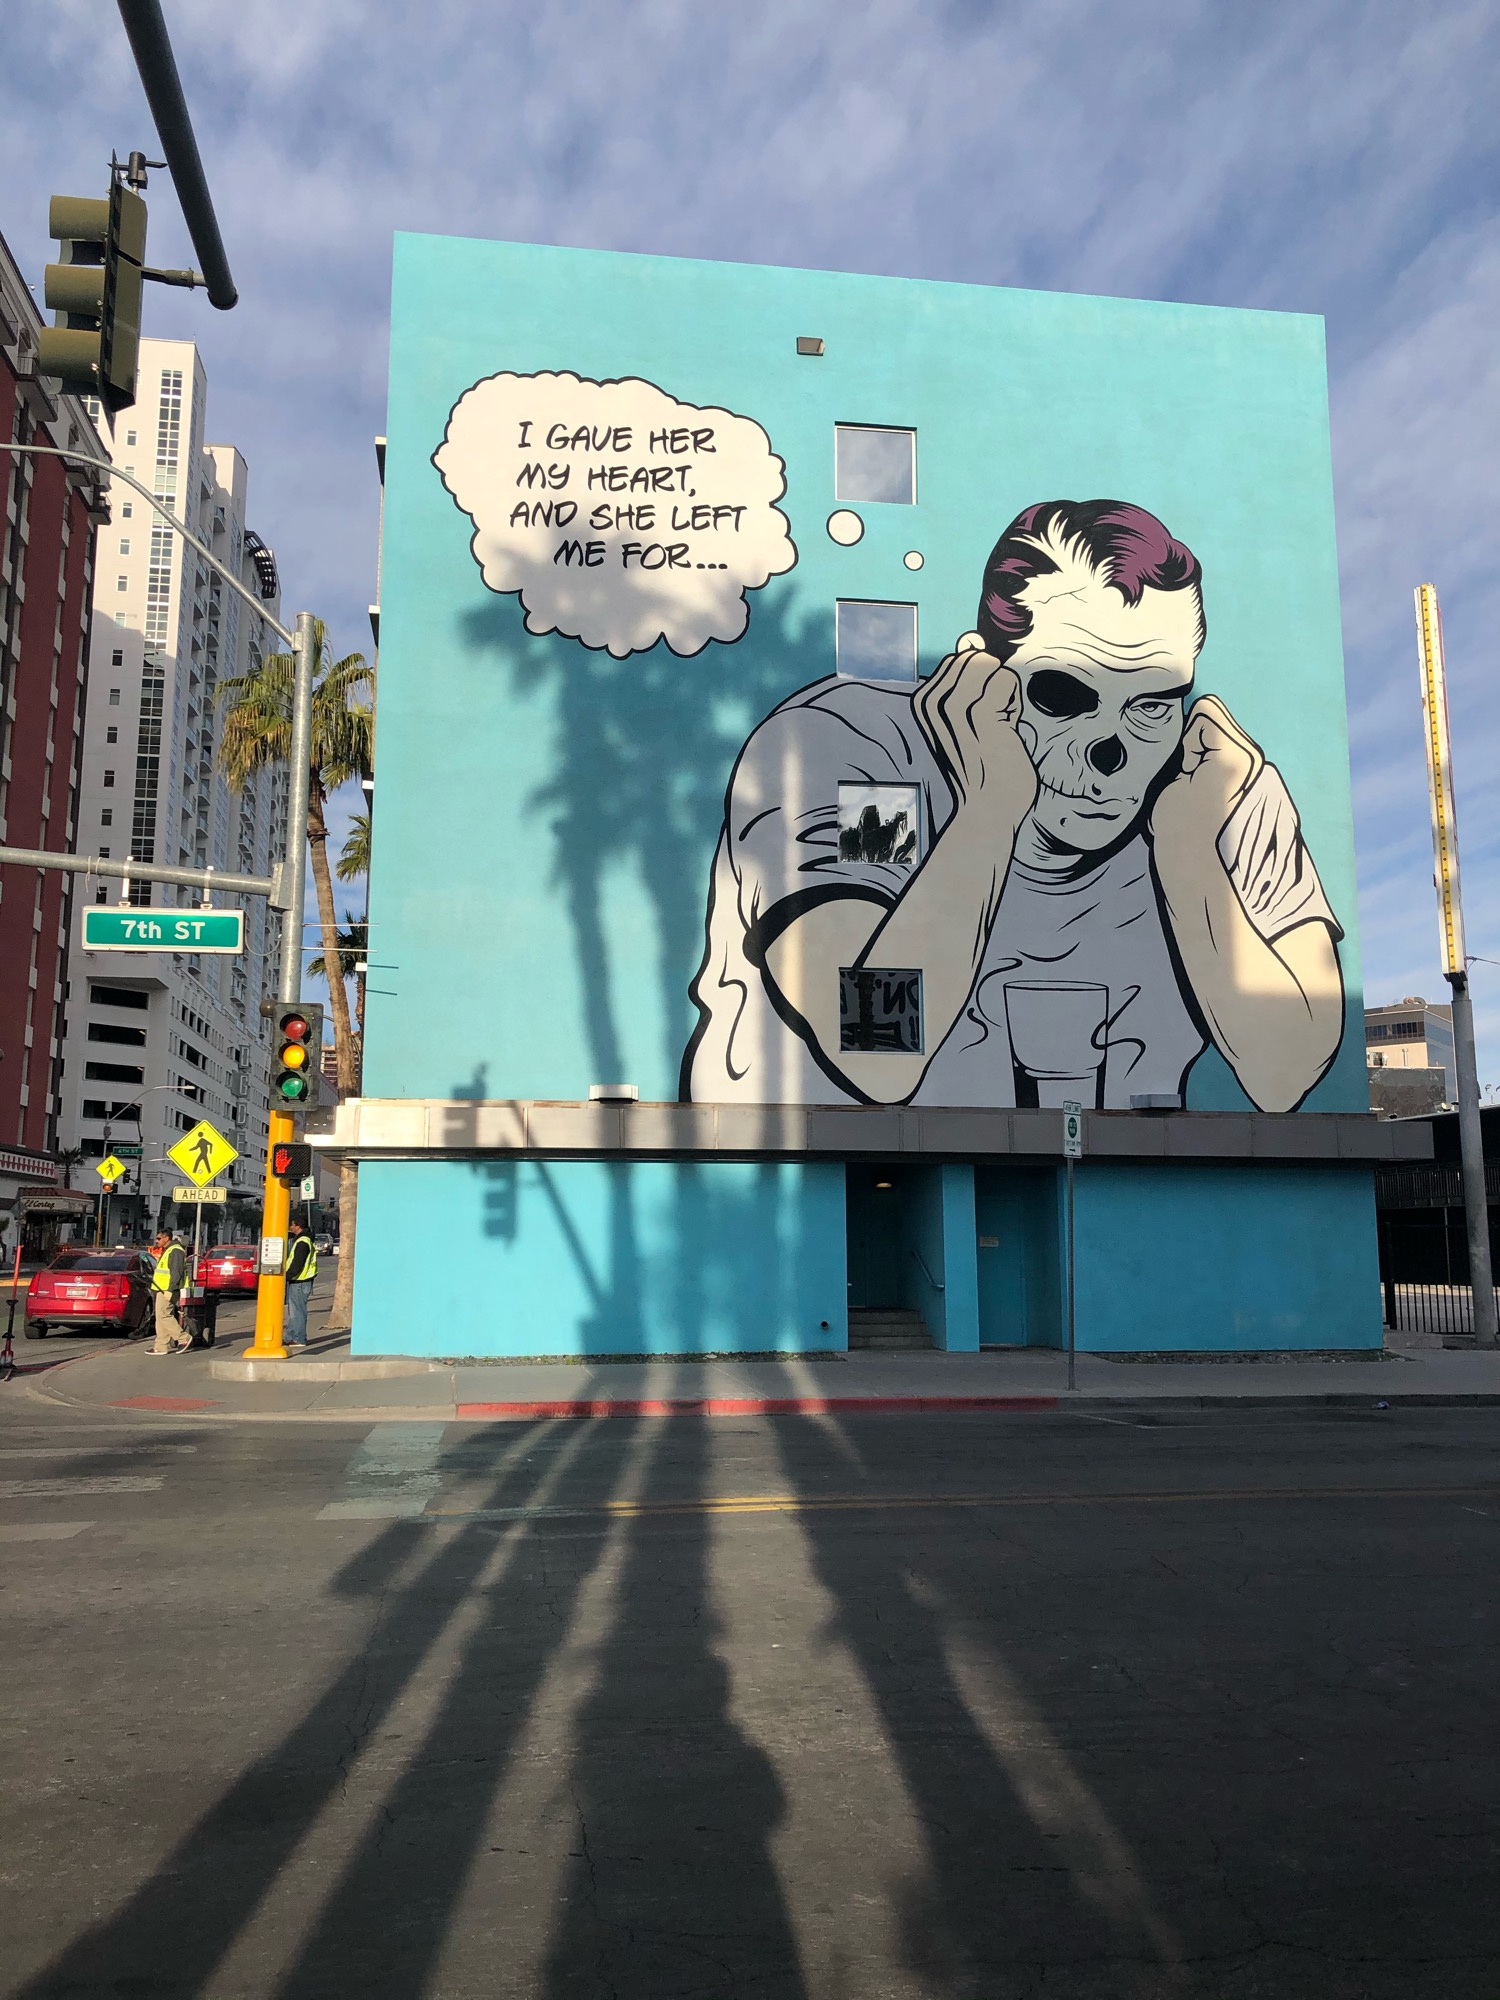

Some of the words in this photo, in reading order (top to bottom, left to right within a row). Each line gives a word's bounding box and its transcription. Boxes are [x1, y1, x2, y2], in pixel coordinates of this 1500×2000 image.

[517, 420, 534, 449] I
[545, 423, 633, 453] GAVE
[649, 427, 717, 455] HER
[515, 462, 571, 491] MY
[587, 464, 696, 498] HEART,
[509, 500, 579, 529] AND
[588, 503, 656, 531] SHE
[671, 504, 748, 533] LEFT
[552, 539, 607, 568] ME
[620, 541, 729, 570] FOR...
[120, 919, 162, 939] 7th
[174, 920, 206, 940] ST
[181, 1189, 219, 1200] AHEAD
